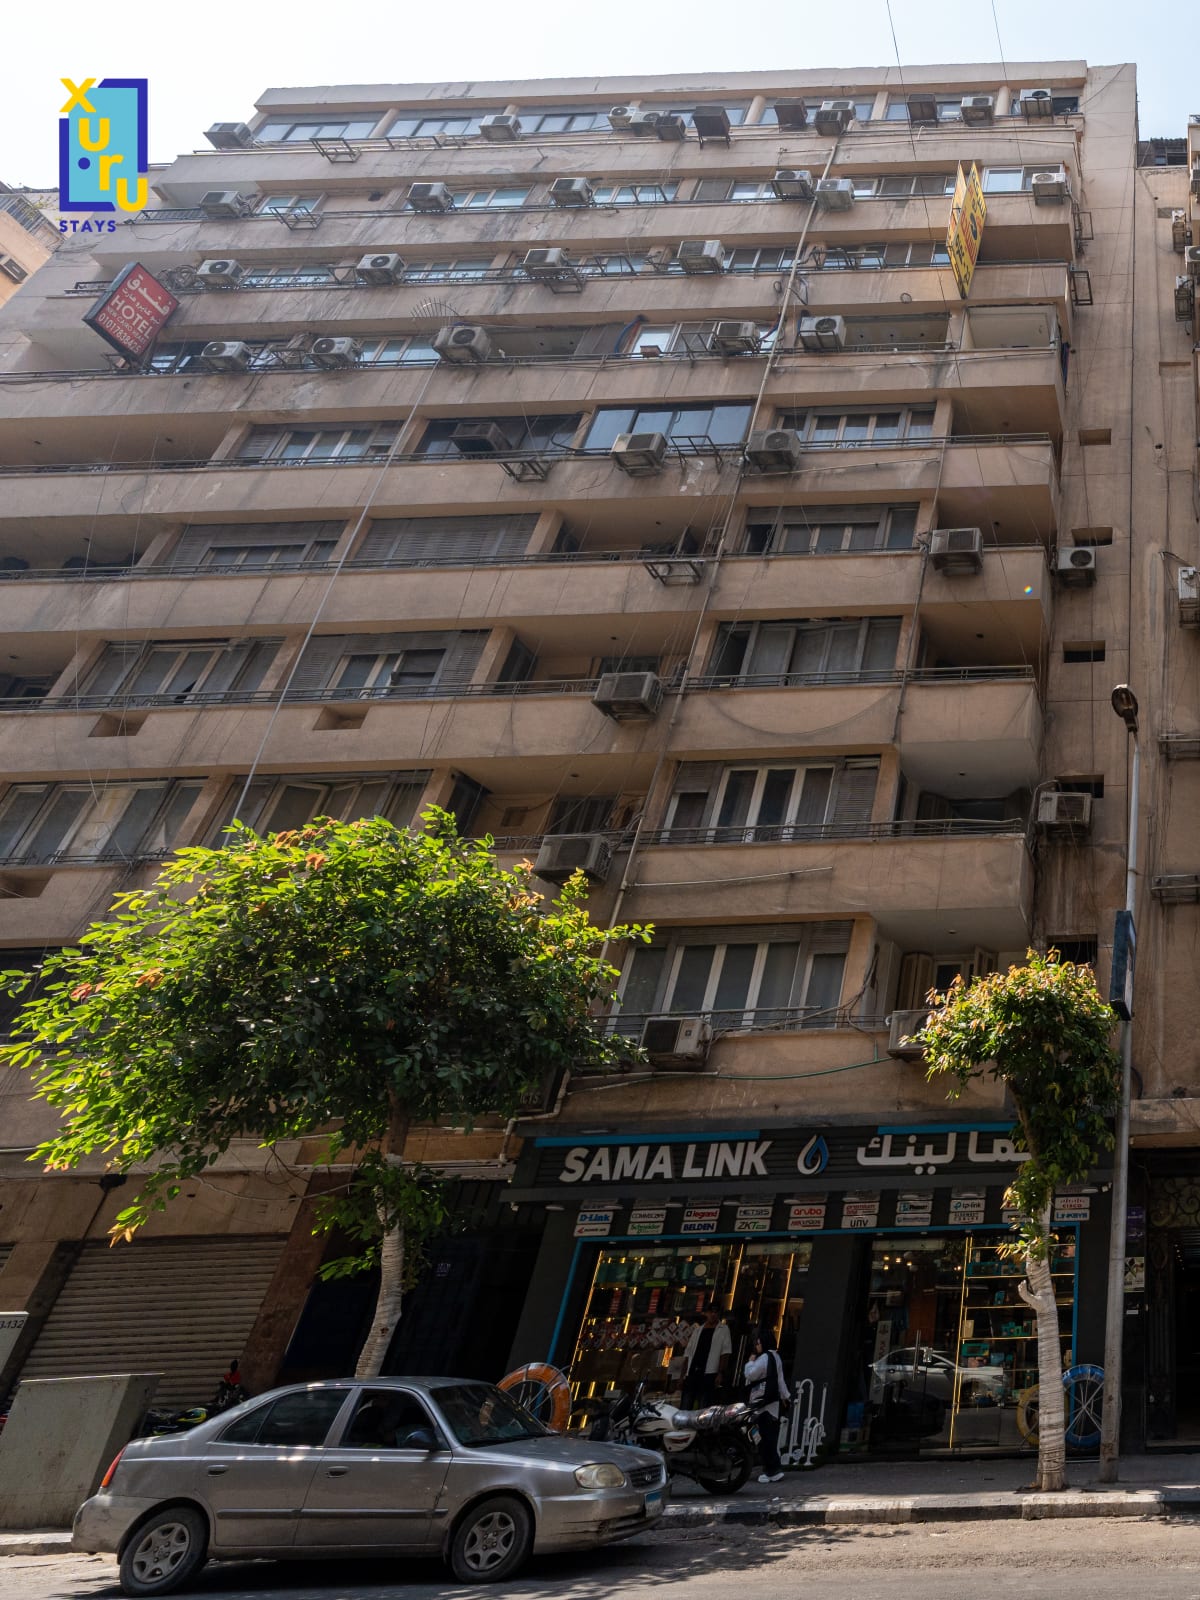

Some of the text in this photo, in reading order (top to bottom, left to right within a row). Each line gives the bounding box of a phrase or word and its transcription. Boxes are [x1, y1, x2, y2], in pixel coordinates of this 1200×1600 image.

[127, 274, 172, 315] فندق
[111, 295, 153, 339] HOTEL
[558, 1140, 773, 1183] SAMA LINK
[856, 1131, 1034, 1175] ما لينك
[579, 1213, 610, 1222] D-Link
[693, 1210, 718, 1220] legrand
[794, 1208, 822, 1216] aruba
[683, 1223, 714, 1231] BELDEN
